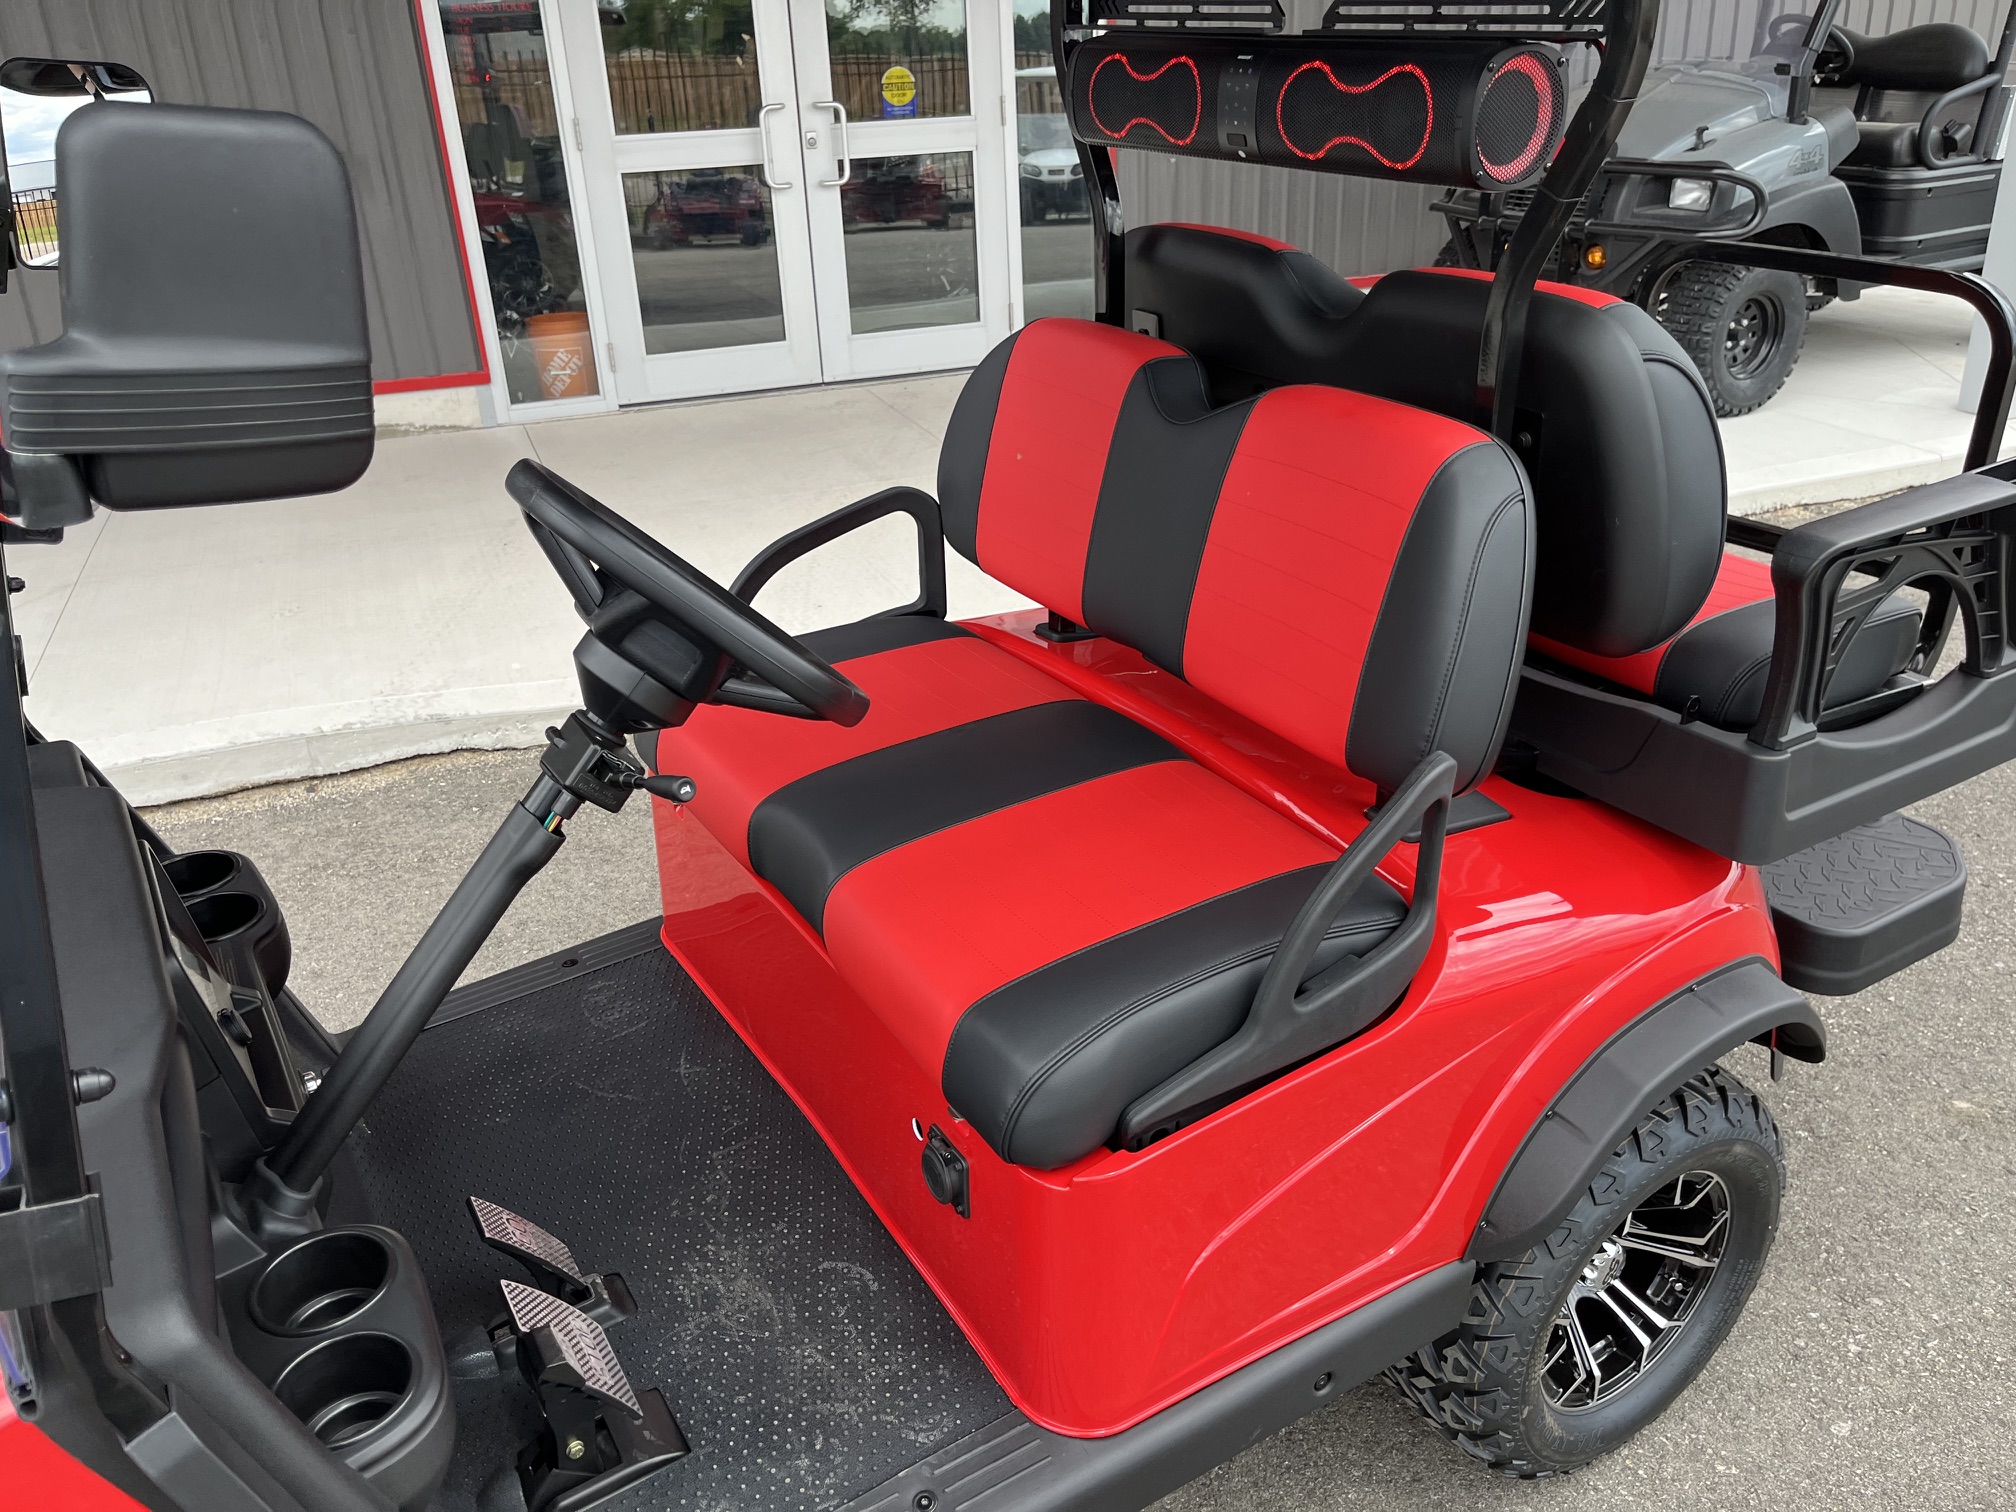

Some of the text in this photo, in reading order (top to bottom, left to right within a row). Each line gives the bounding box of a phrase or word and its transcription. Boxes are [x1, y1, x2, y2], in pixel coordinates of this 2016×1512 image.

[451, 2, 533, 13] BUSINESS HOURS
[883, 83, 915, 91] CAUTION
[541, 349, 572, 386] HOME
[550, 354, 583, 398] DEPOT
